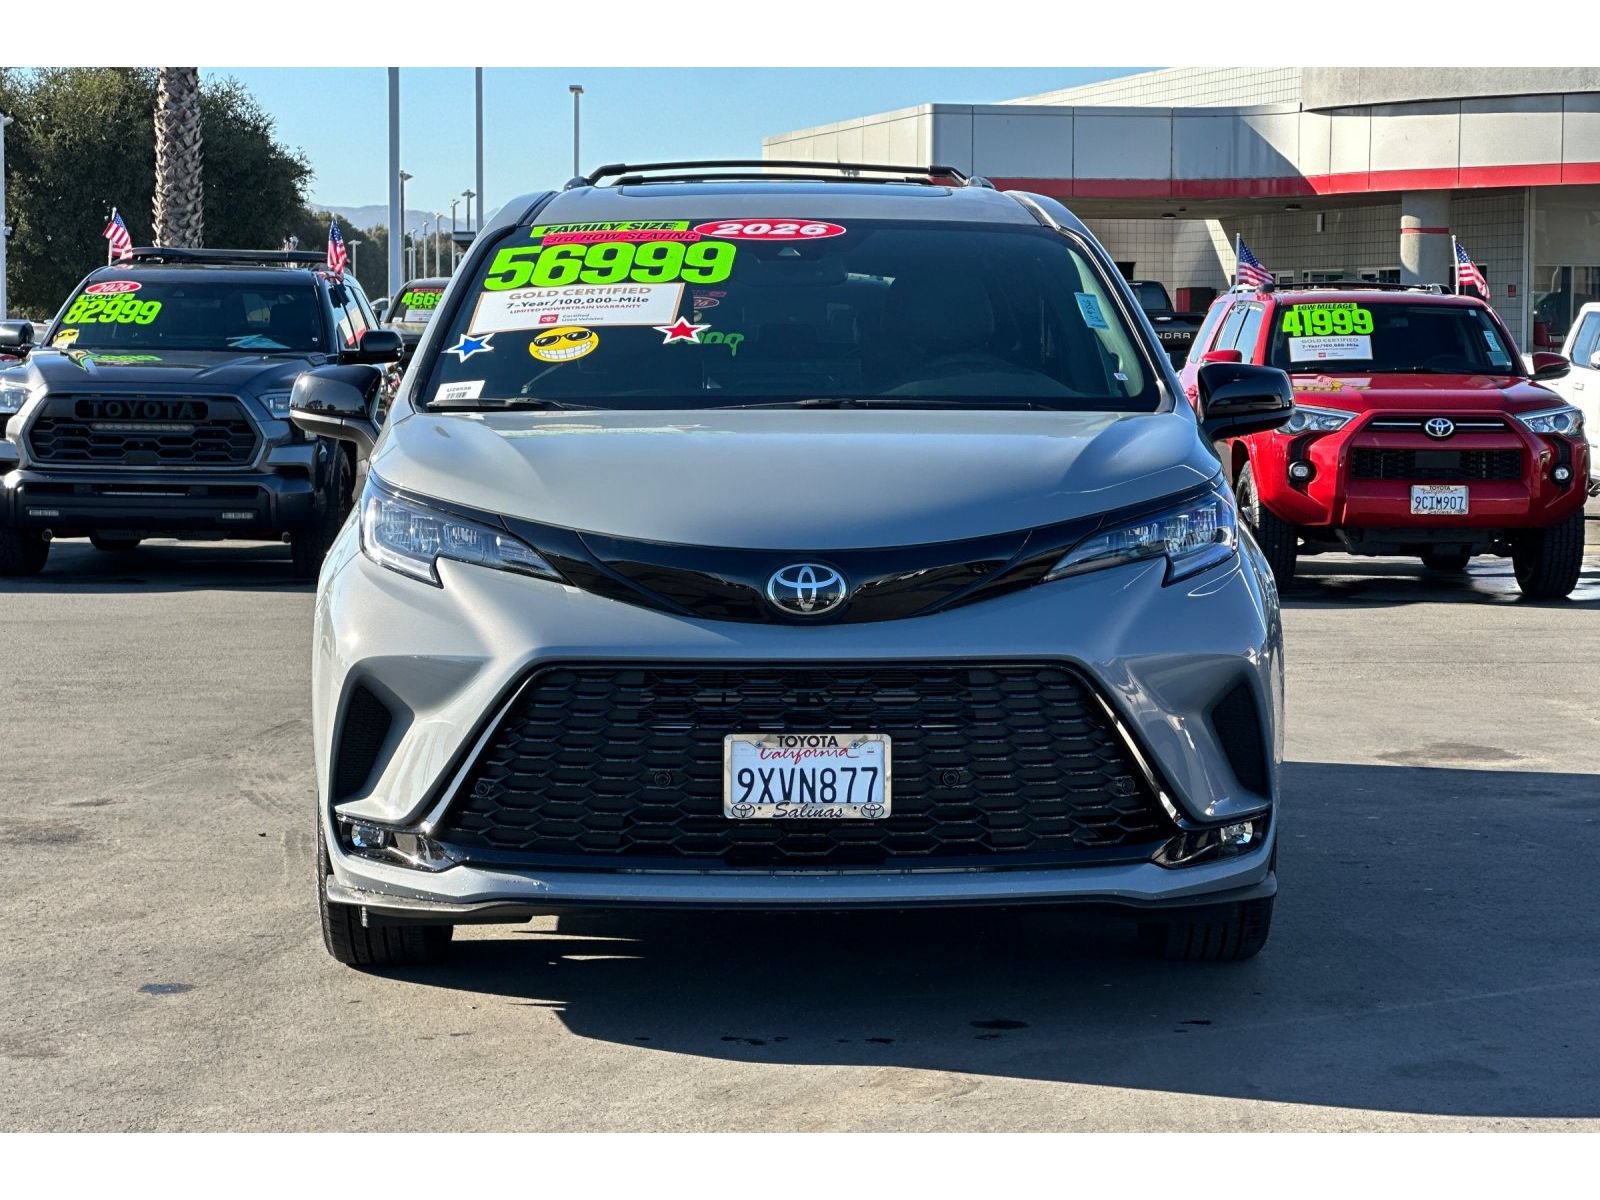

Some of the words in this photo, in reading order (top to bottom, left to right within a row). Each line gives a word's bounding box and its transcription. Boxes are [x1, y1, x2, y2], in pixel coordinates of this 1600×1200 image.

[543, 223, 623, 234] FAMILY
[627, 221, 676, 230] SIZE
[711, 223, 829, 236] 2026
[580, 233, 619, 241] ROW
[626, 232, 696, 240] SEATING
[484, 241, 736, 291] 56999
[100, 284, 131, 293] 2026
[508, 290, 557, 300] GOLD
[562, 287, 651, 297] CERTIFIED
[506, 297, 649, 309] 7-Year/100,000-Mile
[63, 300, 162, 324] 82999
[1282, 309, 1374, 336] 41999
[89, 400, 195, 418] TOYOTA
[1414, 496, 1464, 510] 9CIM907
[777, 735, 838, 747] TOYOTA
[760, 748, 860, 765] California
[737, 767, 878, 803] 9XVN877
[773, 801, 843, 818] Salinas
